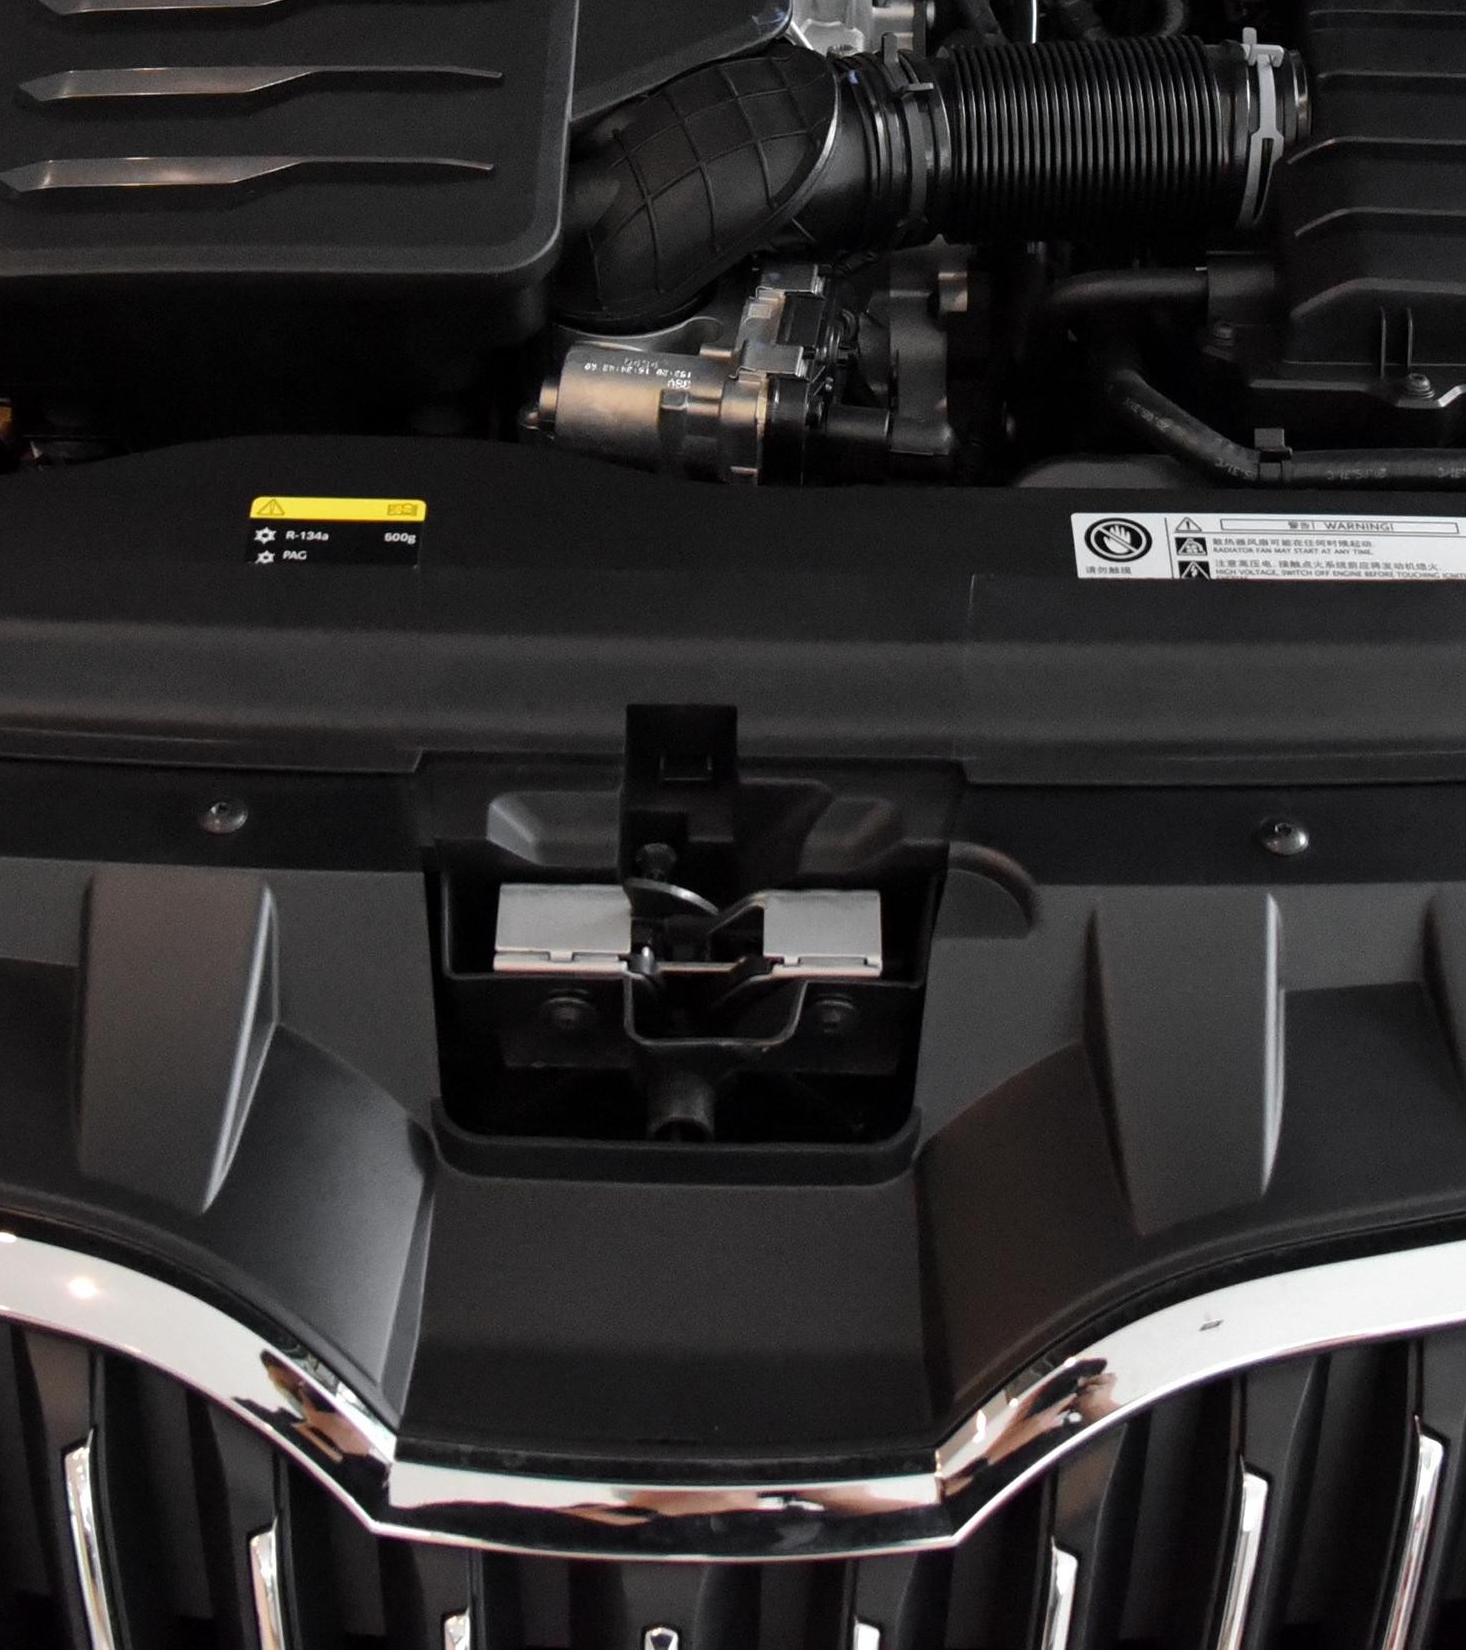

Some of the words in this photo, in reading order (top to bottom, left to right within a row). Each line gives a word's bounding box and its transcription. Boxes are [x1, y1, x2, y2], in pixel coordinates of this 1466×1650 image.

[1324, 522, 1394, 531] WARNING!
[285, 530, 329, 542] R-134a
[384, 532, 416, 545] 600g
[282, 550, 307, 561] PAG
[1332, 570, 1362, 578] ENGINE
